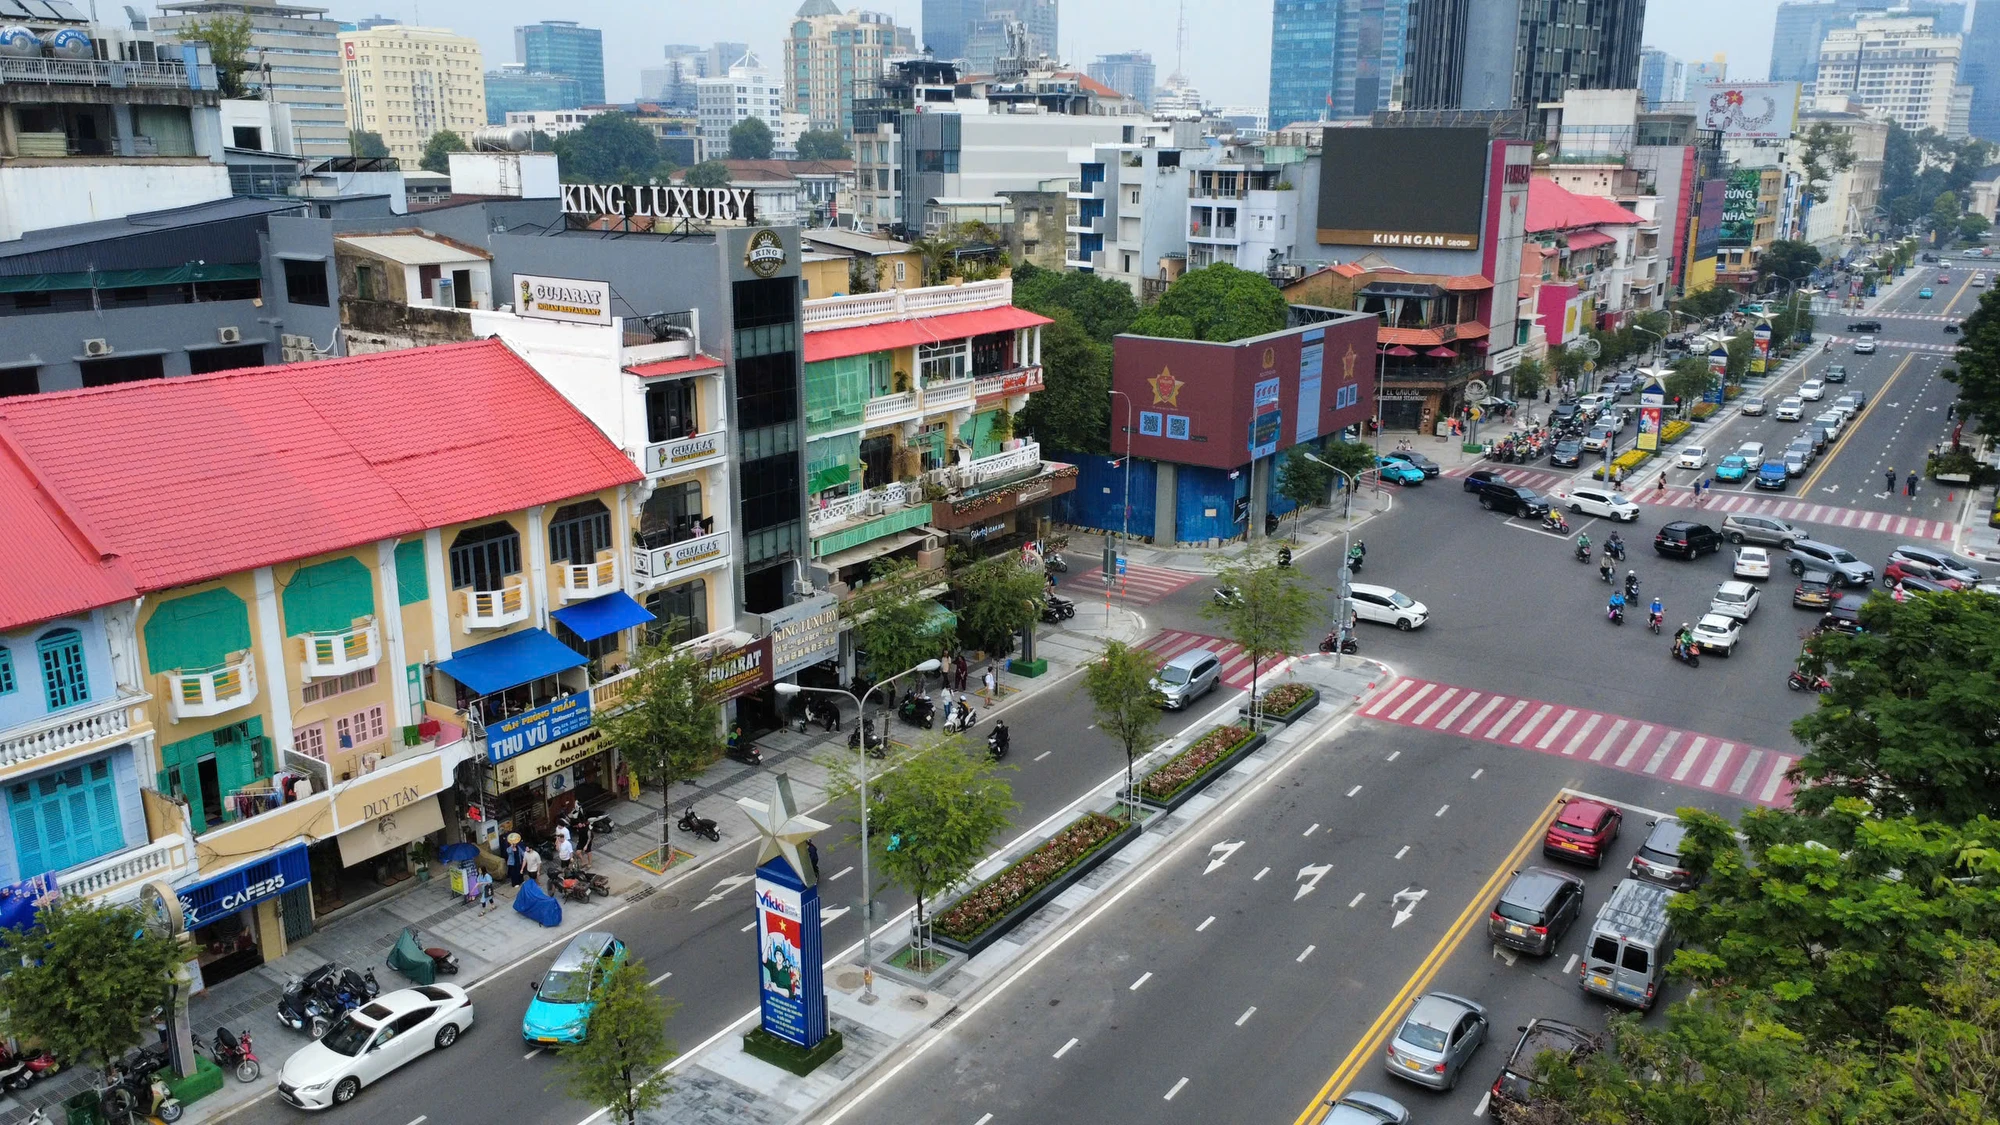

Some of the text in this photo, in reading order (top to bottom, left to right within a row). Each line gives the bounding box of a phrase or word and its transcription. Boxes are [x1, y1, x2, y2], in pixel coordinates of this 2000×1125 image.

[560, 184, 752, 221] KING LUXURY
[1373, 233, 1471, 247] KIM NGAN GROUP
[755, 248, 778, 258] KING
[536, 284, 602, 305] GUJARAT
[537, 302, 601, 316] INDIAN RESTAURANT
[672, 439, 715, 457] GUJARAT
[676, 540, 720, 560] GUJARAT
[773, 623, 799, 643] KING
[801, 608, 839, 633] LUXURY
[708, 649, 762, 684] GUJARAT
[727, 666, 761, 684] RESTAURANT
[501, 720, 520, 733] VĂN
[522, 709, 550, 726] PHÒNG
[491, 720, 548, 760] THU VŨ
[559, 730, 602, 753] ALLUVIA
[536, 764, 552, 775] The
[554, 746, 595, 768] Chocolate
[363, 785, 419, 820] DUY TÂN
[221, 874, 285, 910] CAFE25
[756, 889, 785, 913] Vikki
